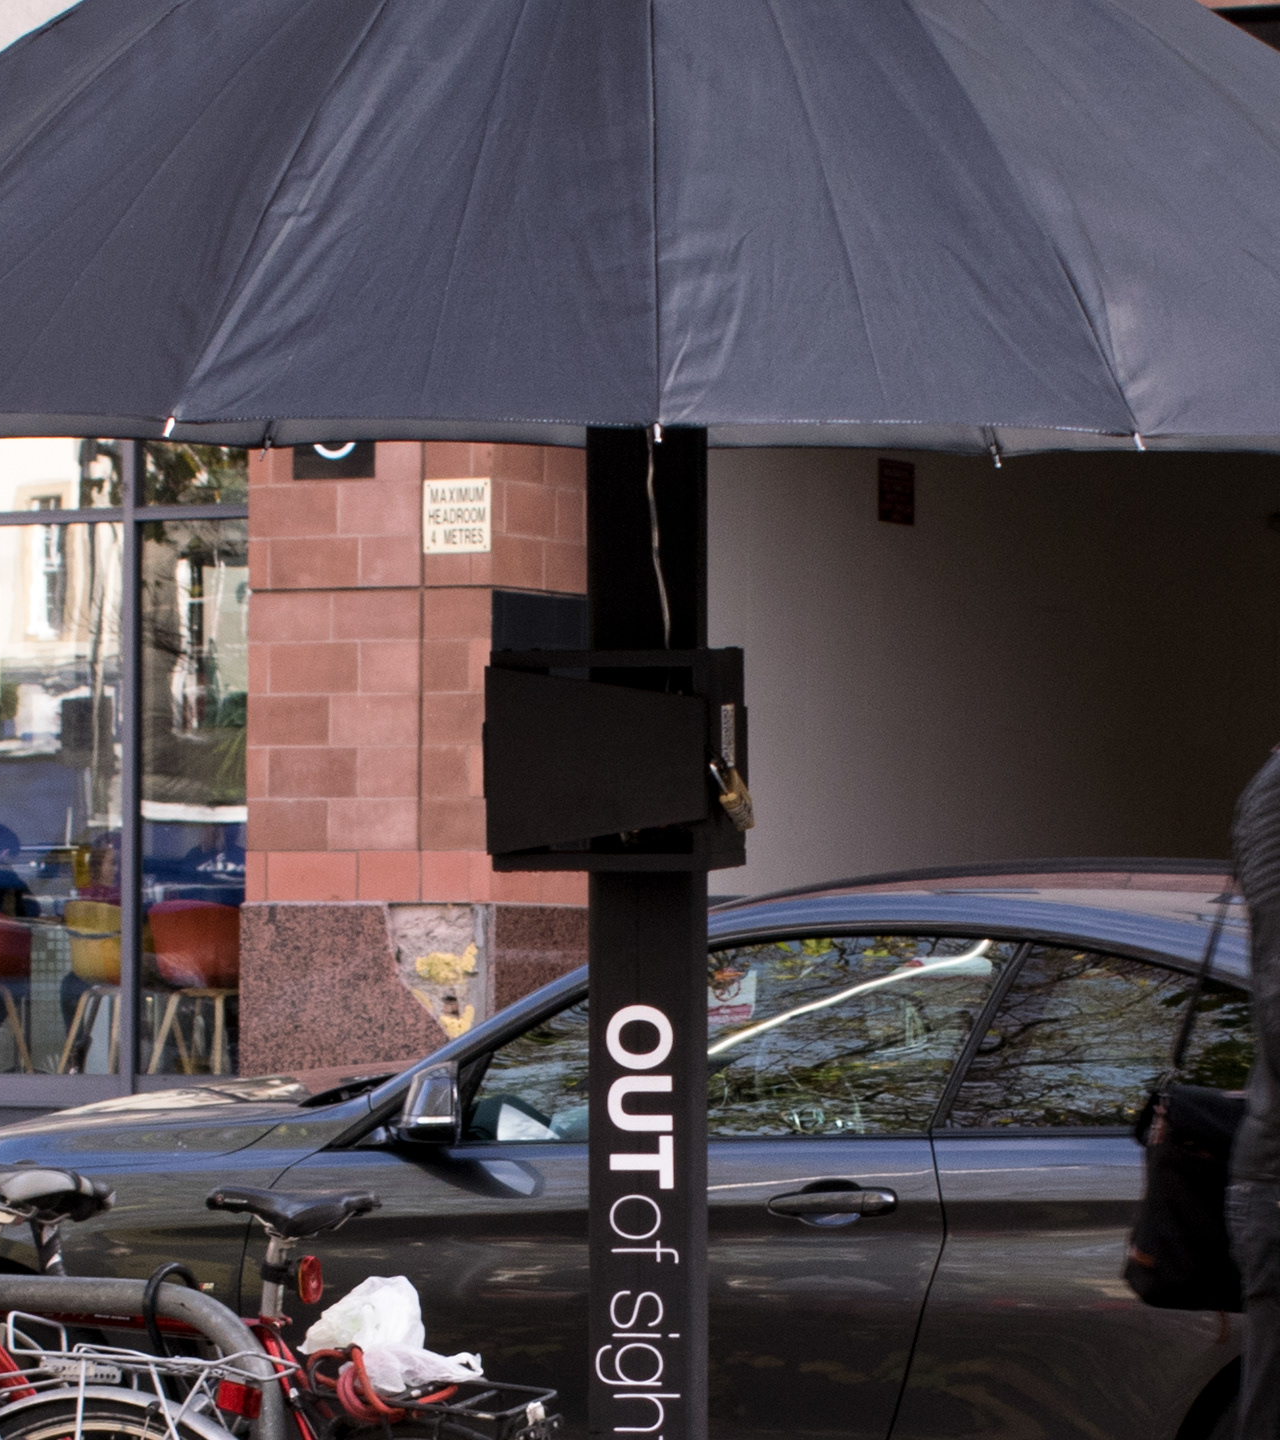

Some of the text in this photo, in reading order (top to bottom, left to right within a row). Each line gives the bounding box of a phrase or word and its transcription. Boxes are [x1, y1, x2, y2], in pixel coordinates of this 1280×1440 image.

[430, 486, 485, 503] MAXIMUM
[428, 507, 486, 526] HEADROOM
[431, 528, 484, 545] 4 METRES
